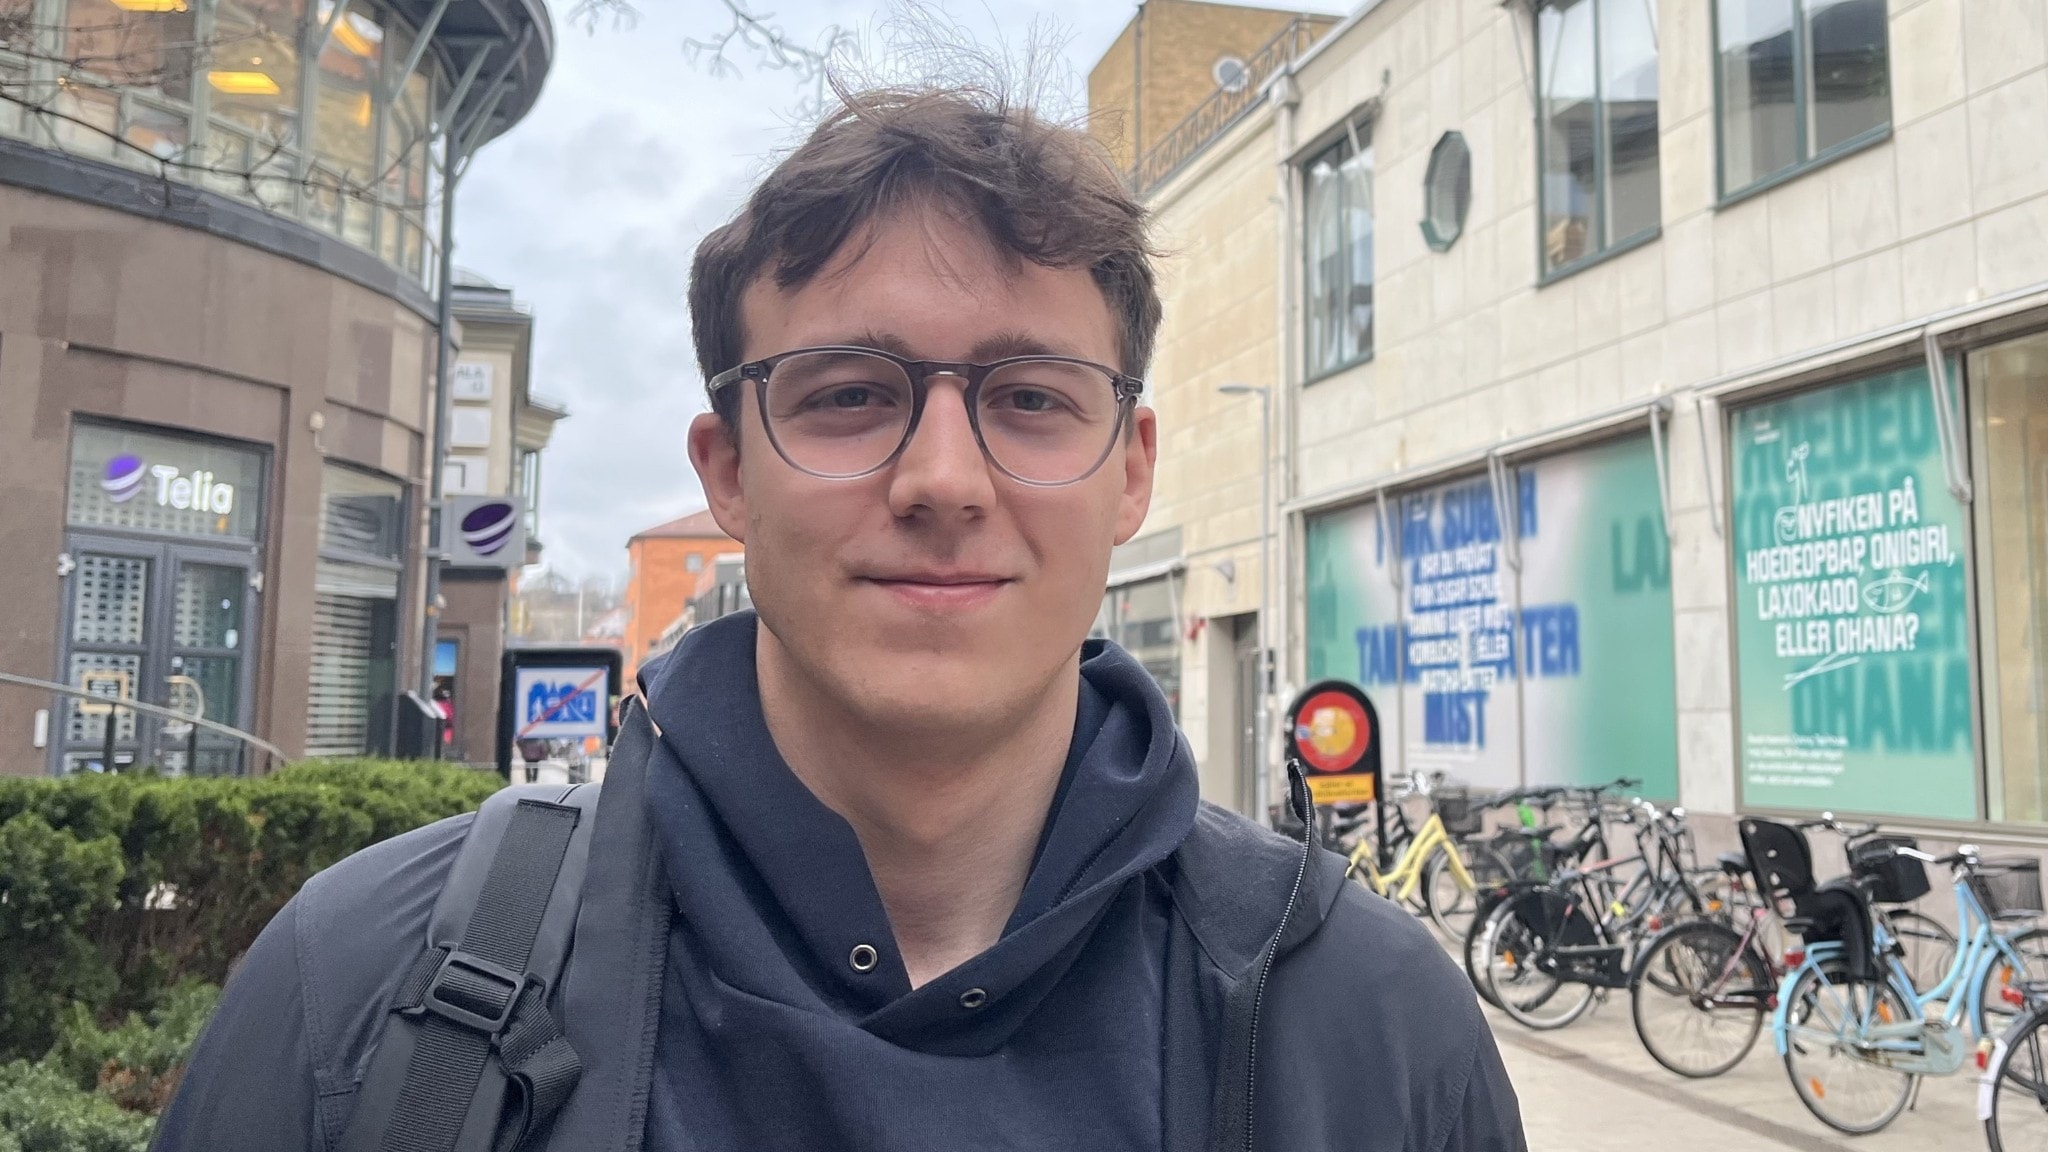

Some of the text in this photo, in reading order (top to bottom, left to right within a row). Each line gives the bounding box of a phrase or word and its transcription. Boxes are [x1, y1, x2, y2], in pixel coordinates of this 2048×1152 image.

[151, 464, 234, 514] Telia
[1798, 491, 1884, 538] NYFIKEN
[1888, 475, 1919, 527] PÅ
[1870, 524, 1955, 571] ONIGIRI,
[1757, 576, 1859, 621] LAXOKADO
[1776, 613, 1919, 657] ELLER OHANA?
